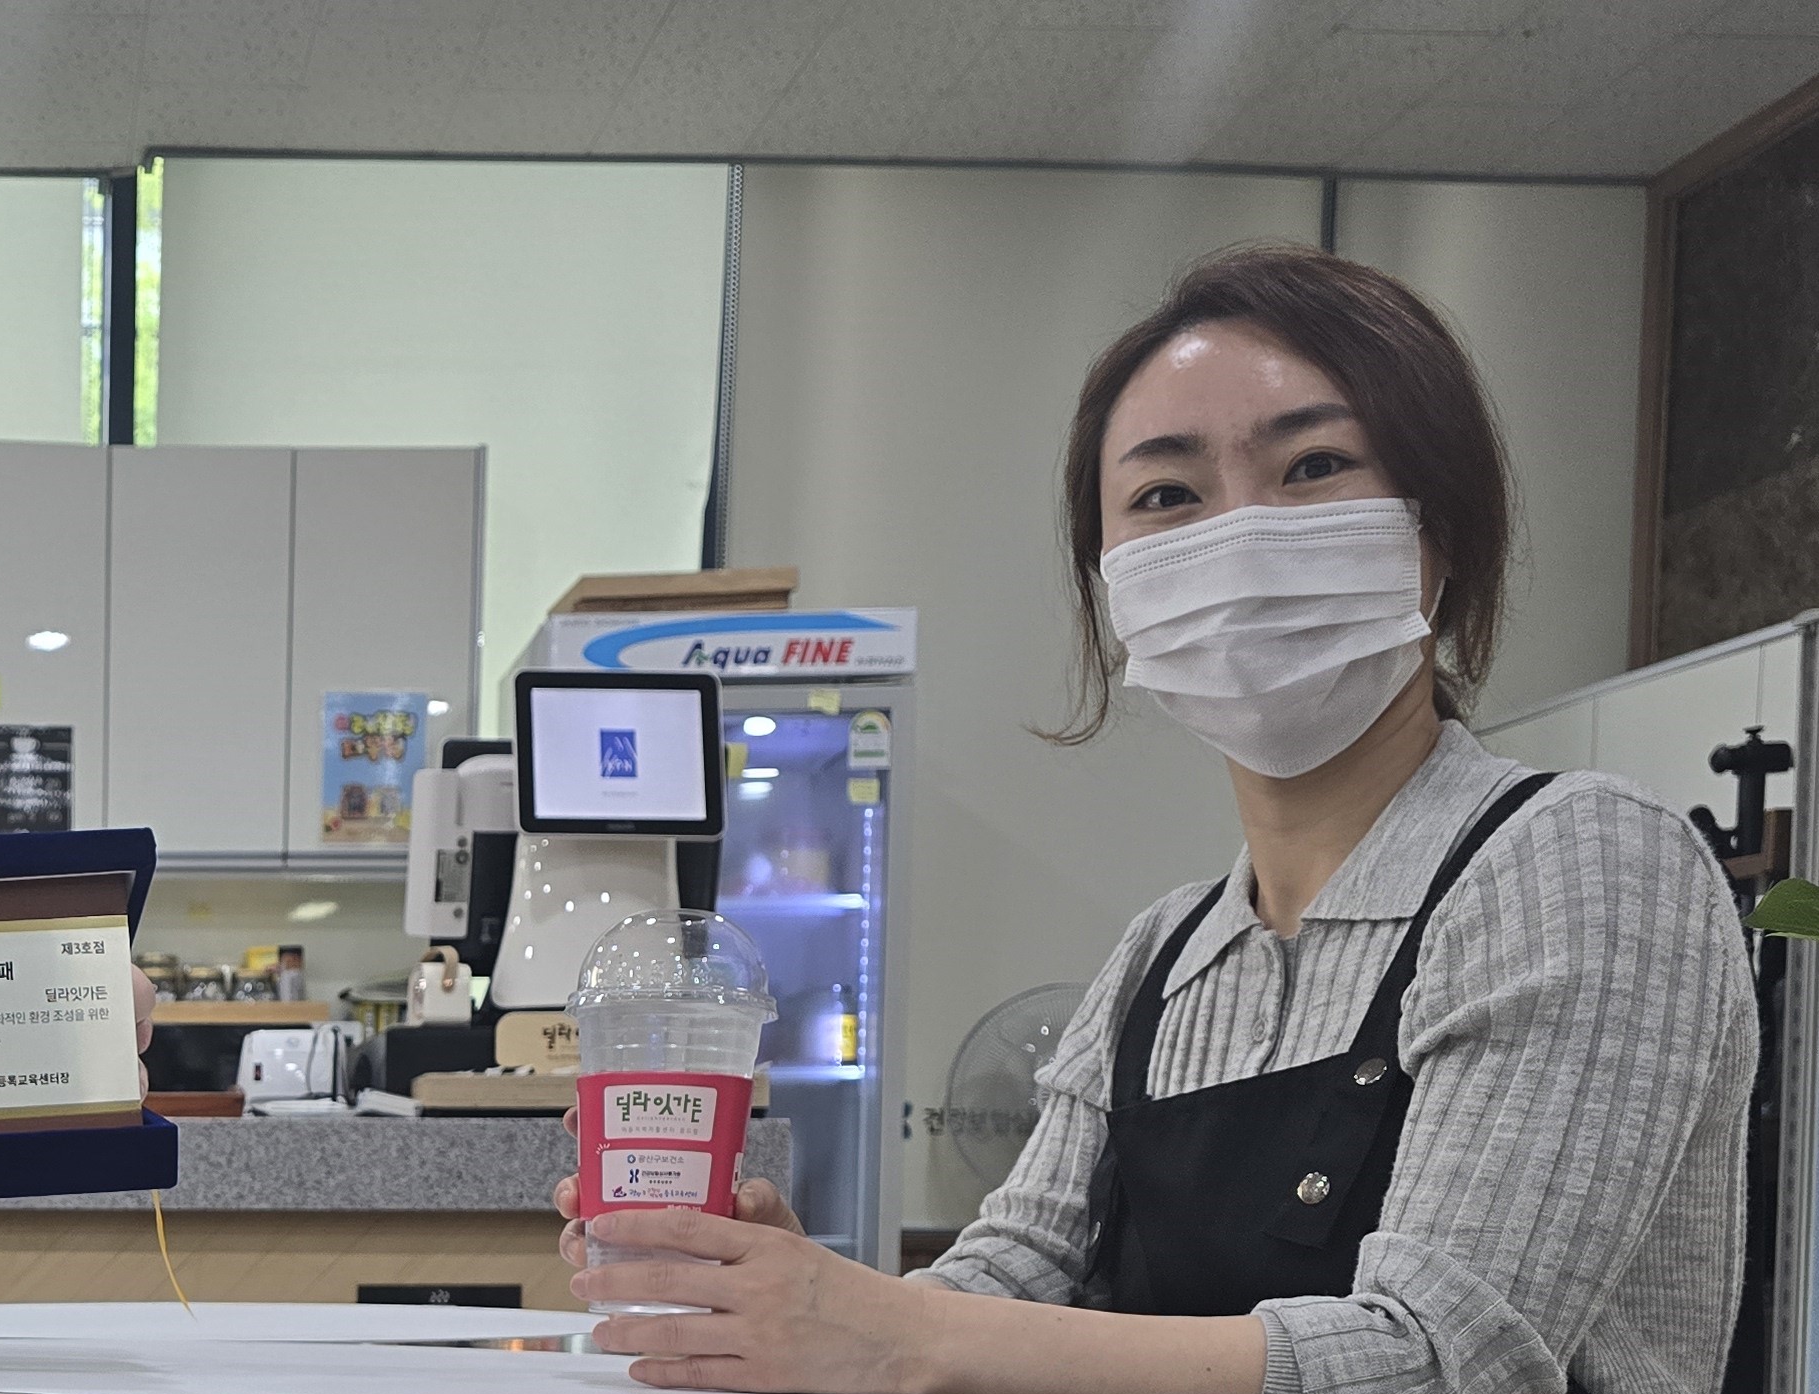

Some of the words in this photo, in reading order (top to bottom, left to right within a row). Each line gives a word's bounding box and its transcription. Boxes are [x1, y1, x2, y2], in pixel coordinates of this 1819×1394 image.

[682, 639, 773, 670] Aqua
[781, 637, 855, 667] FINE
[60, 941, 106, 955] 제3호점
[45, 985, 108, 1003] 딜라잇가든
[29, 1010, 50, 1024] 환경
[53, 1009, 85, 1022] 조성을
[88, 1007, 110, 1021] 위한
[616, 1090, 702, 1123] 딜라잇가든
